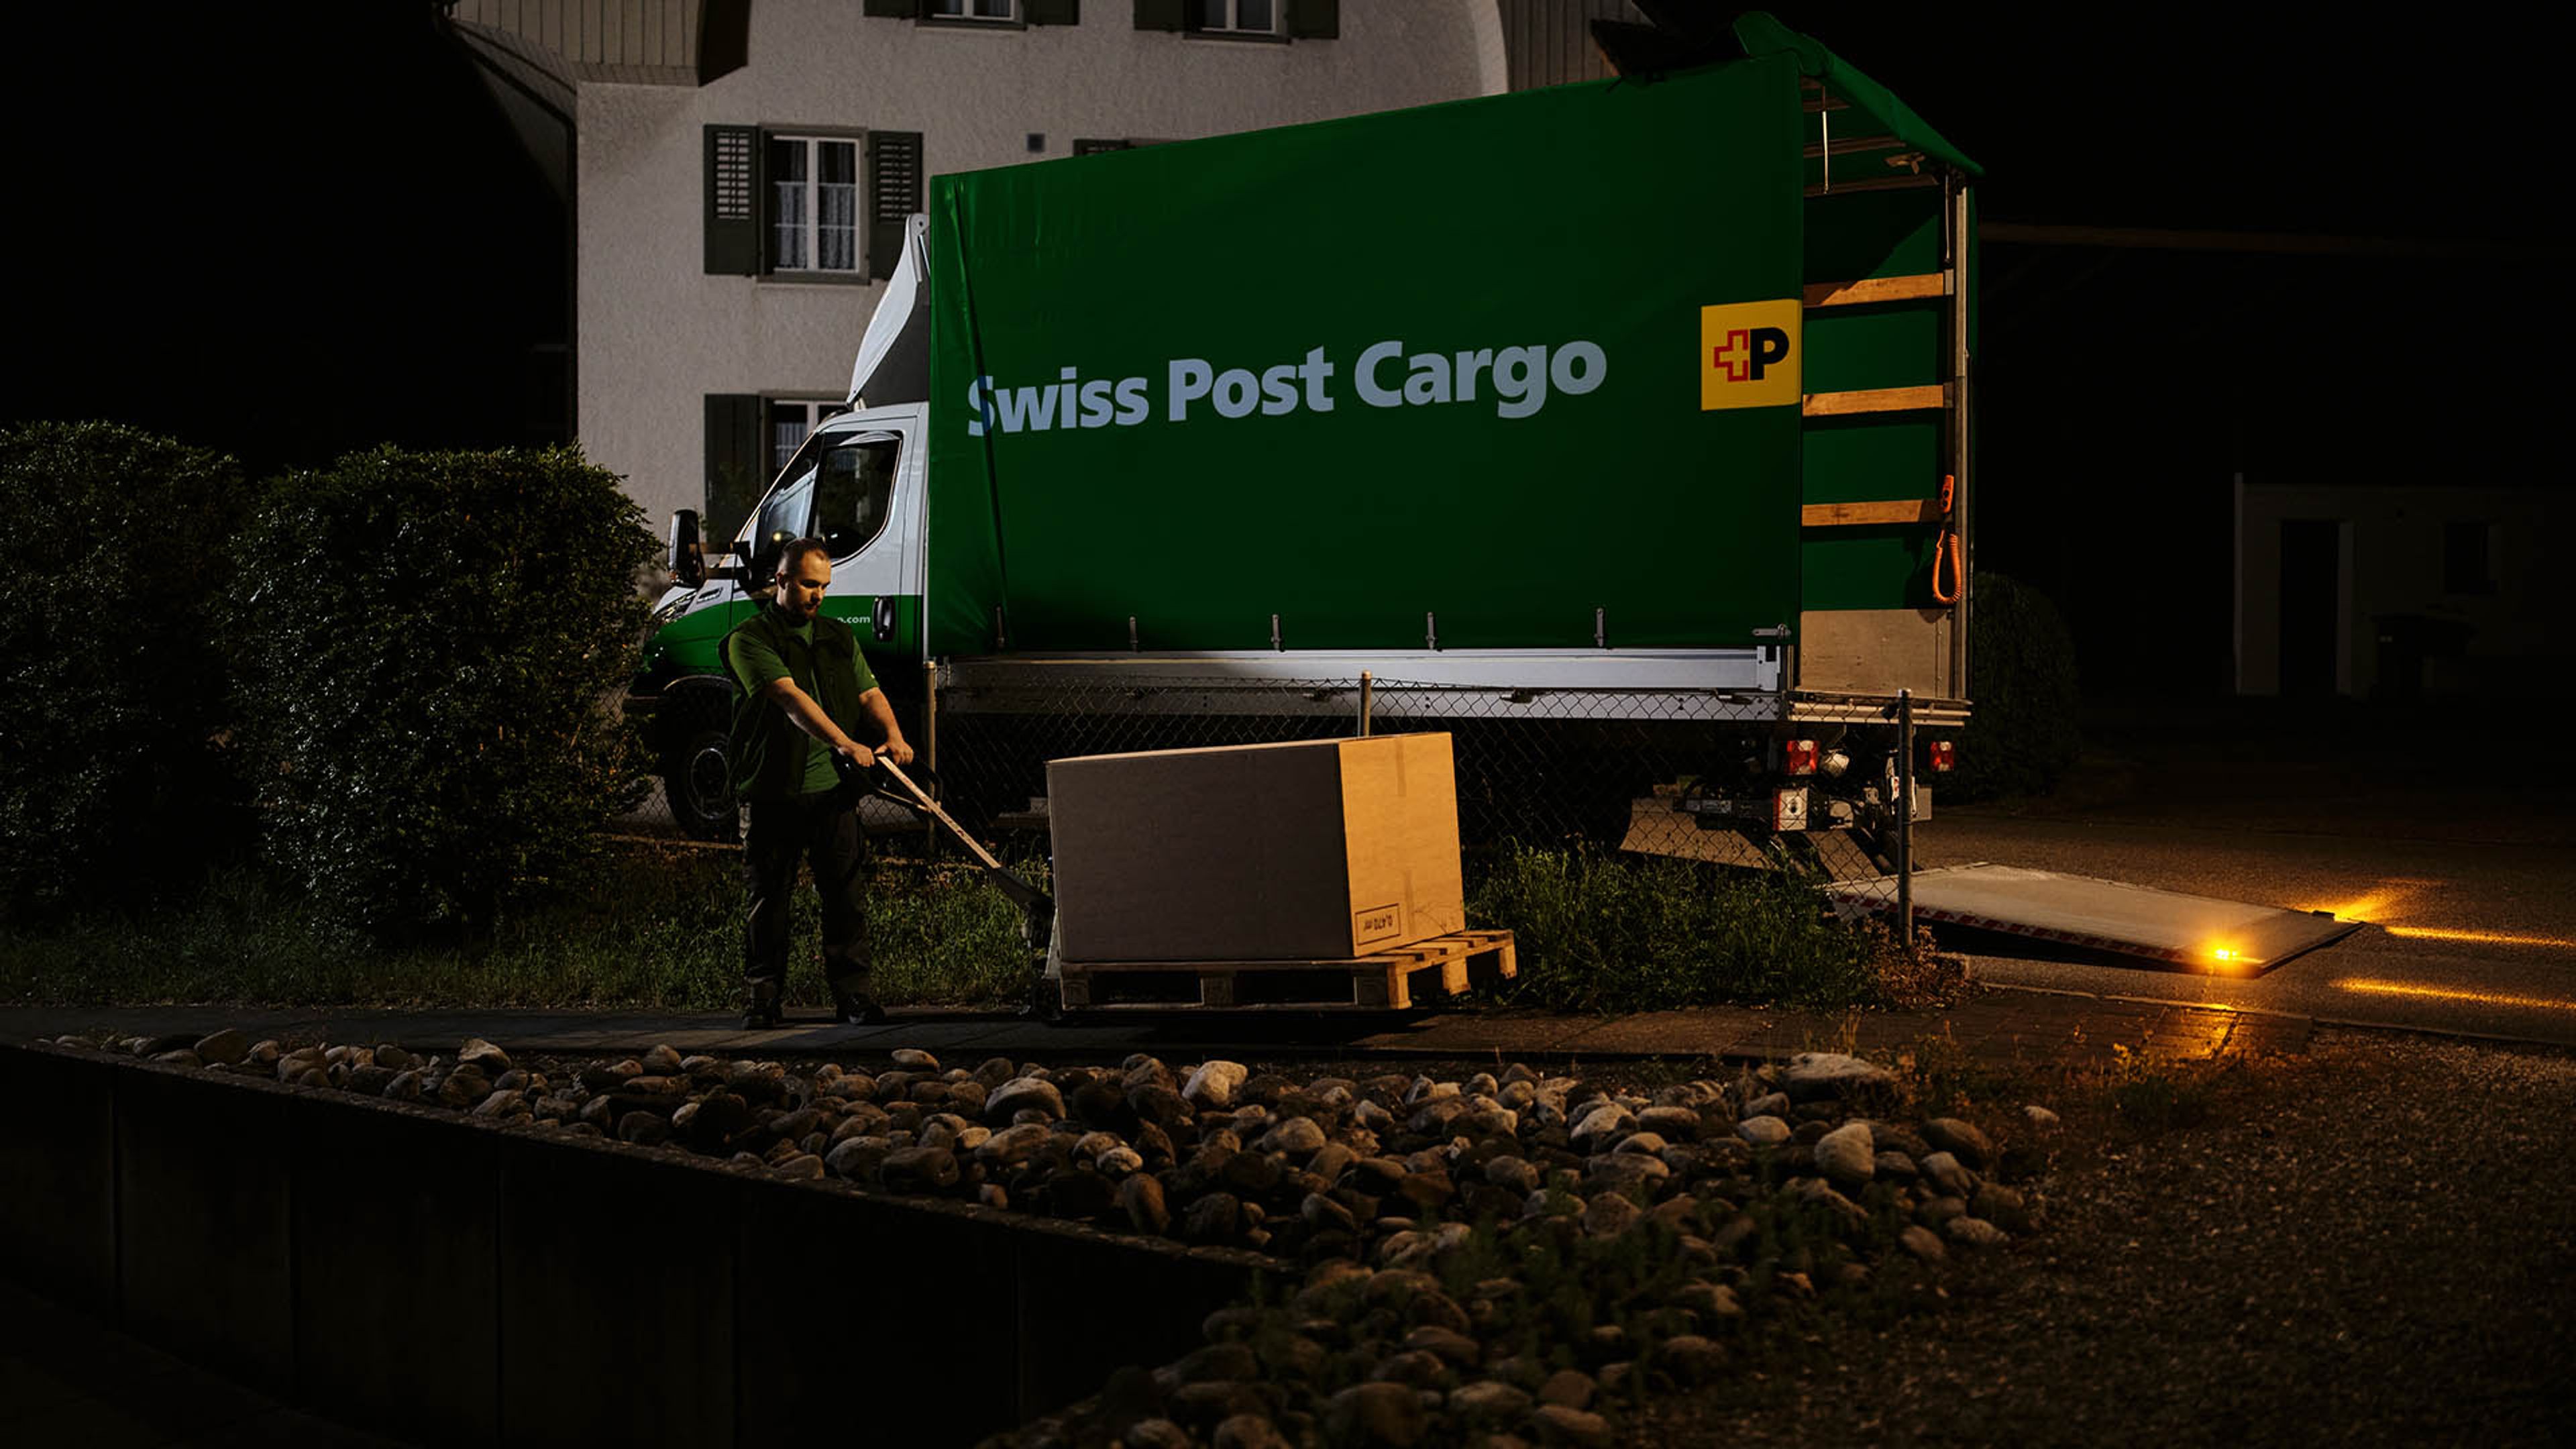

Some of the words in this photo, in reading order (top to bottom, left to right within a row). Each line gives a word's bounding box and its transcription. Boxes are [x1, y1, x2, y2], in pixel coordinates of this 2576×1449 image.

[968, 367, 1149, 436] Swiss
[1169, 345, 1334, 421] Post
[1354, 341, 1607, 418] Cargo
[1750, 327, 1789, 380] P
